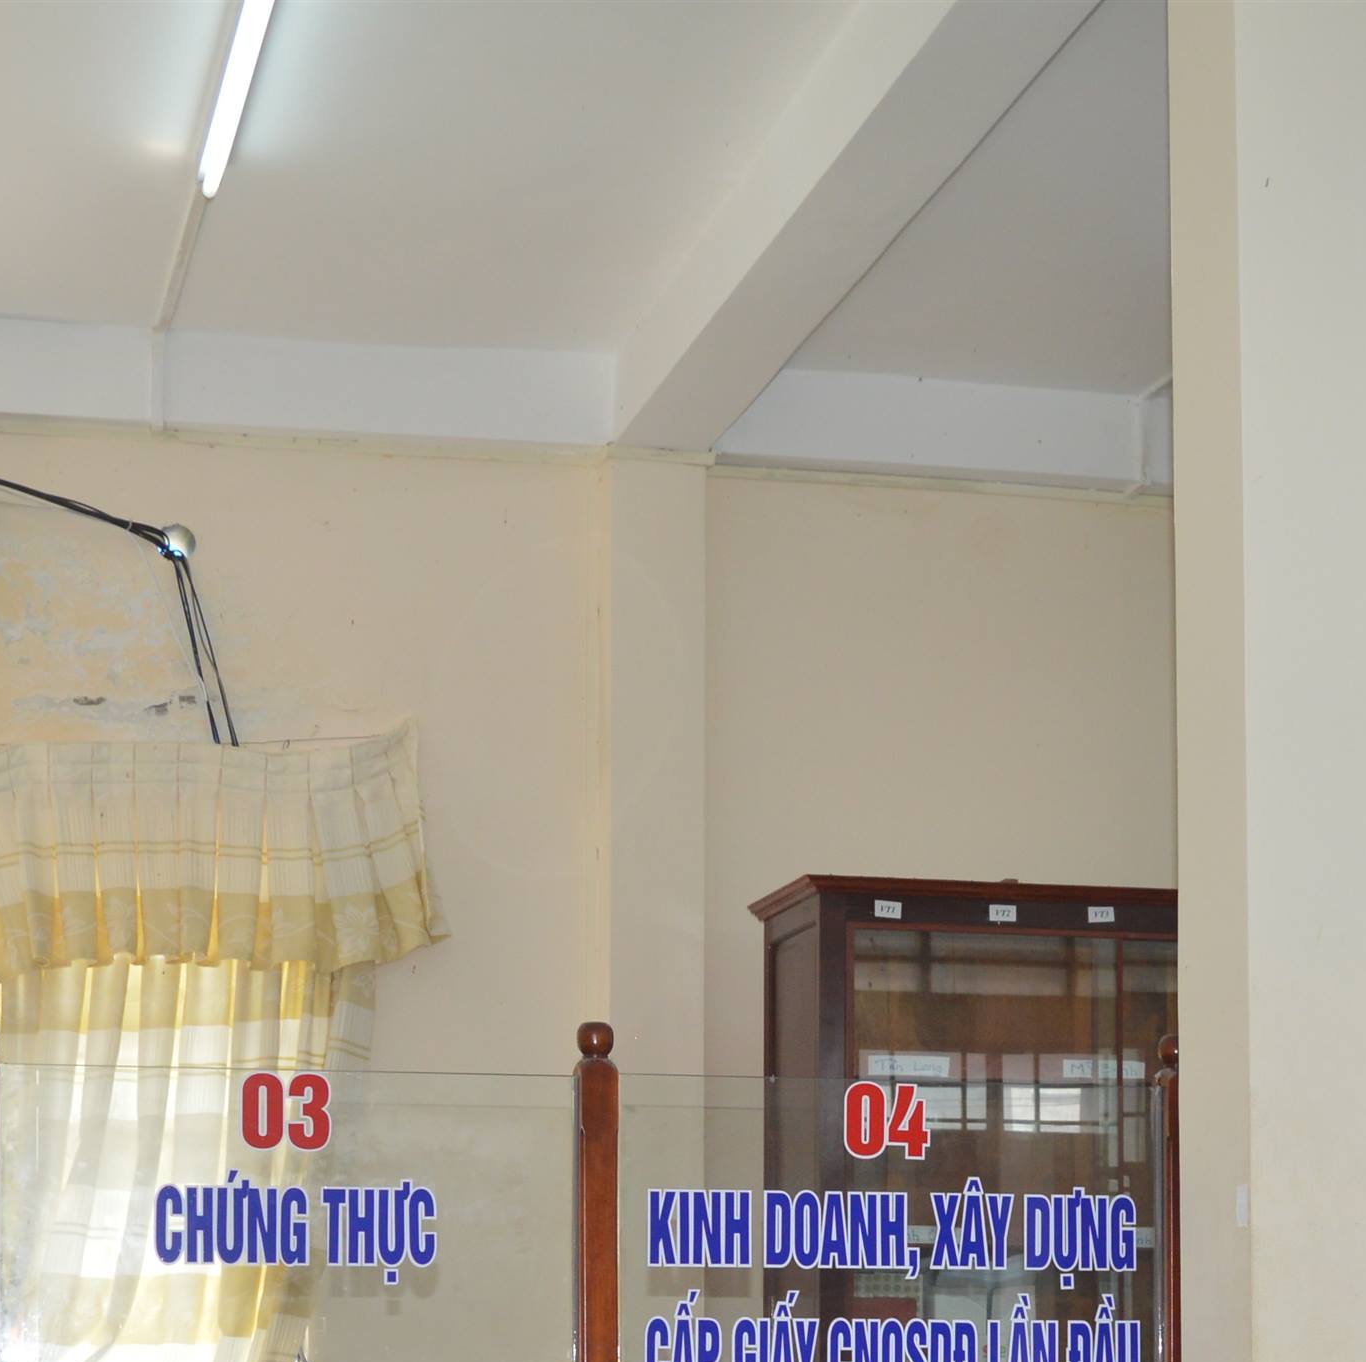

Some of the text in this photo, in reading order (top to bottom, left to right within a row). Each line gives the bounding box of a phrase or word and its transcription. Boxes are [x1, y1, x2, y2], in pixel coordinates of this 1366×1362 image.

[241, 1071, 332, 1150] 03
[844, 1081, 930, 1160] 04
[154, 1169, 436, 1285] CHỨNG THỰC
[648, 1177, 1137, 1289] KINH DOANH, XÂY DỰNG
